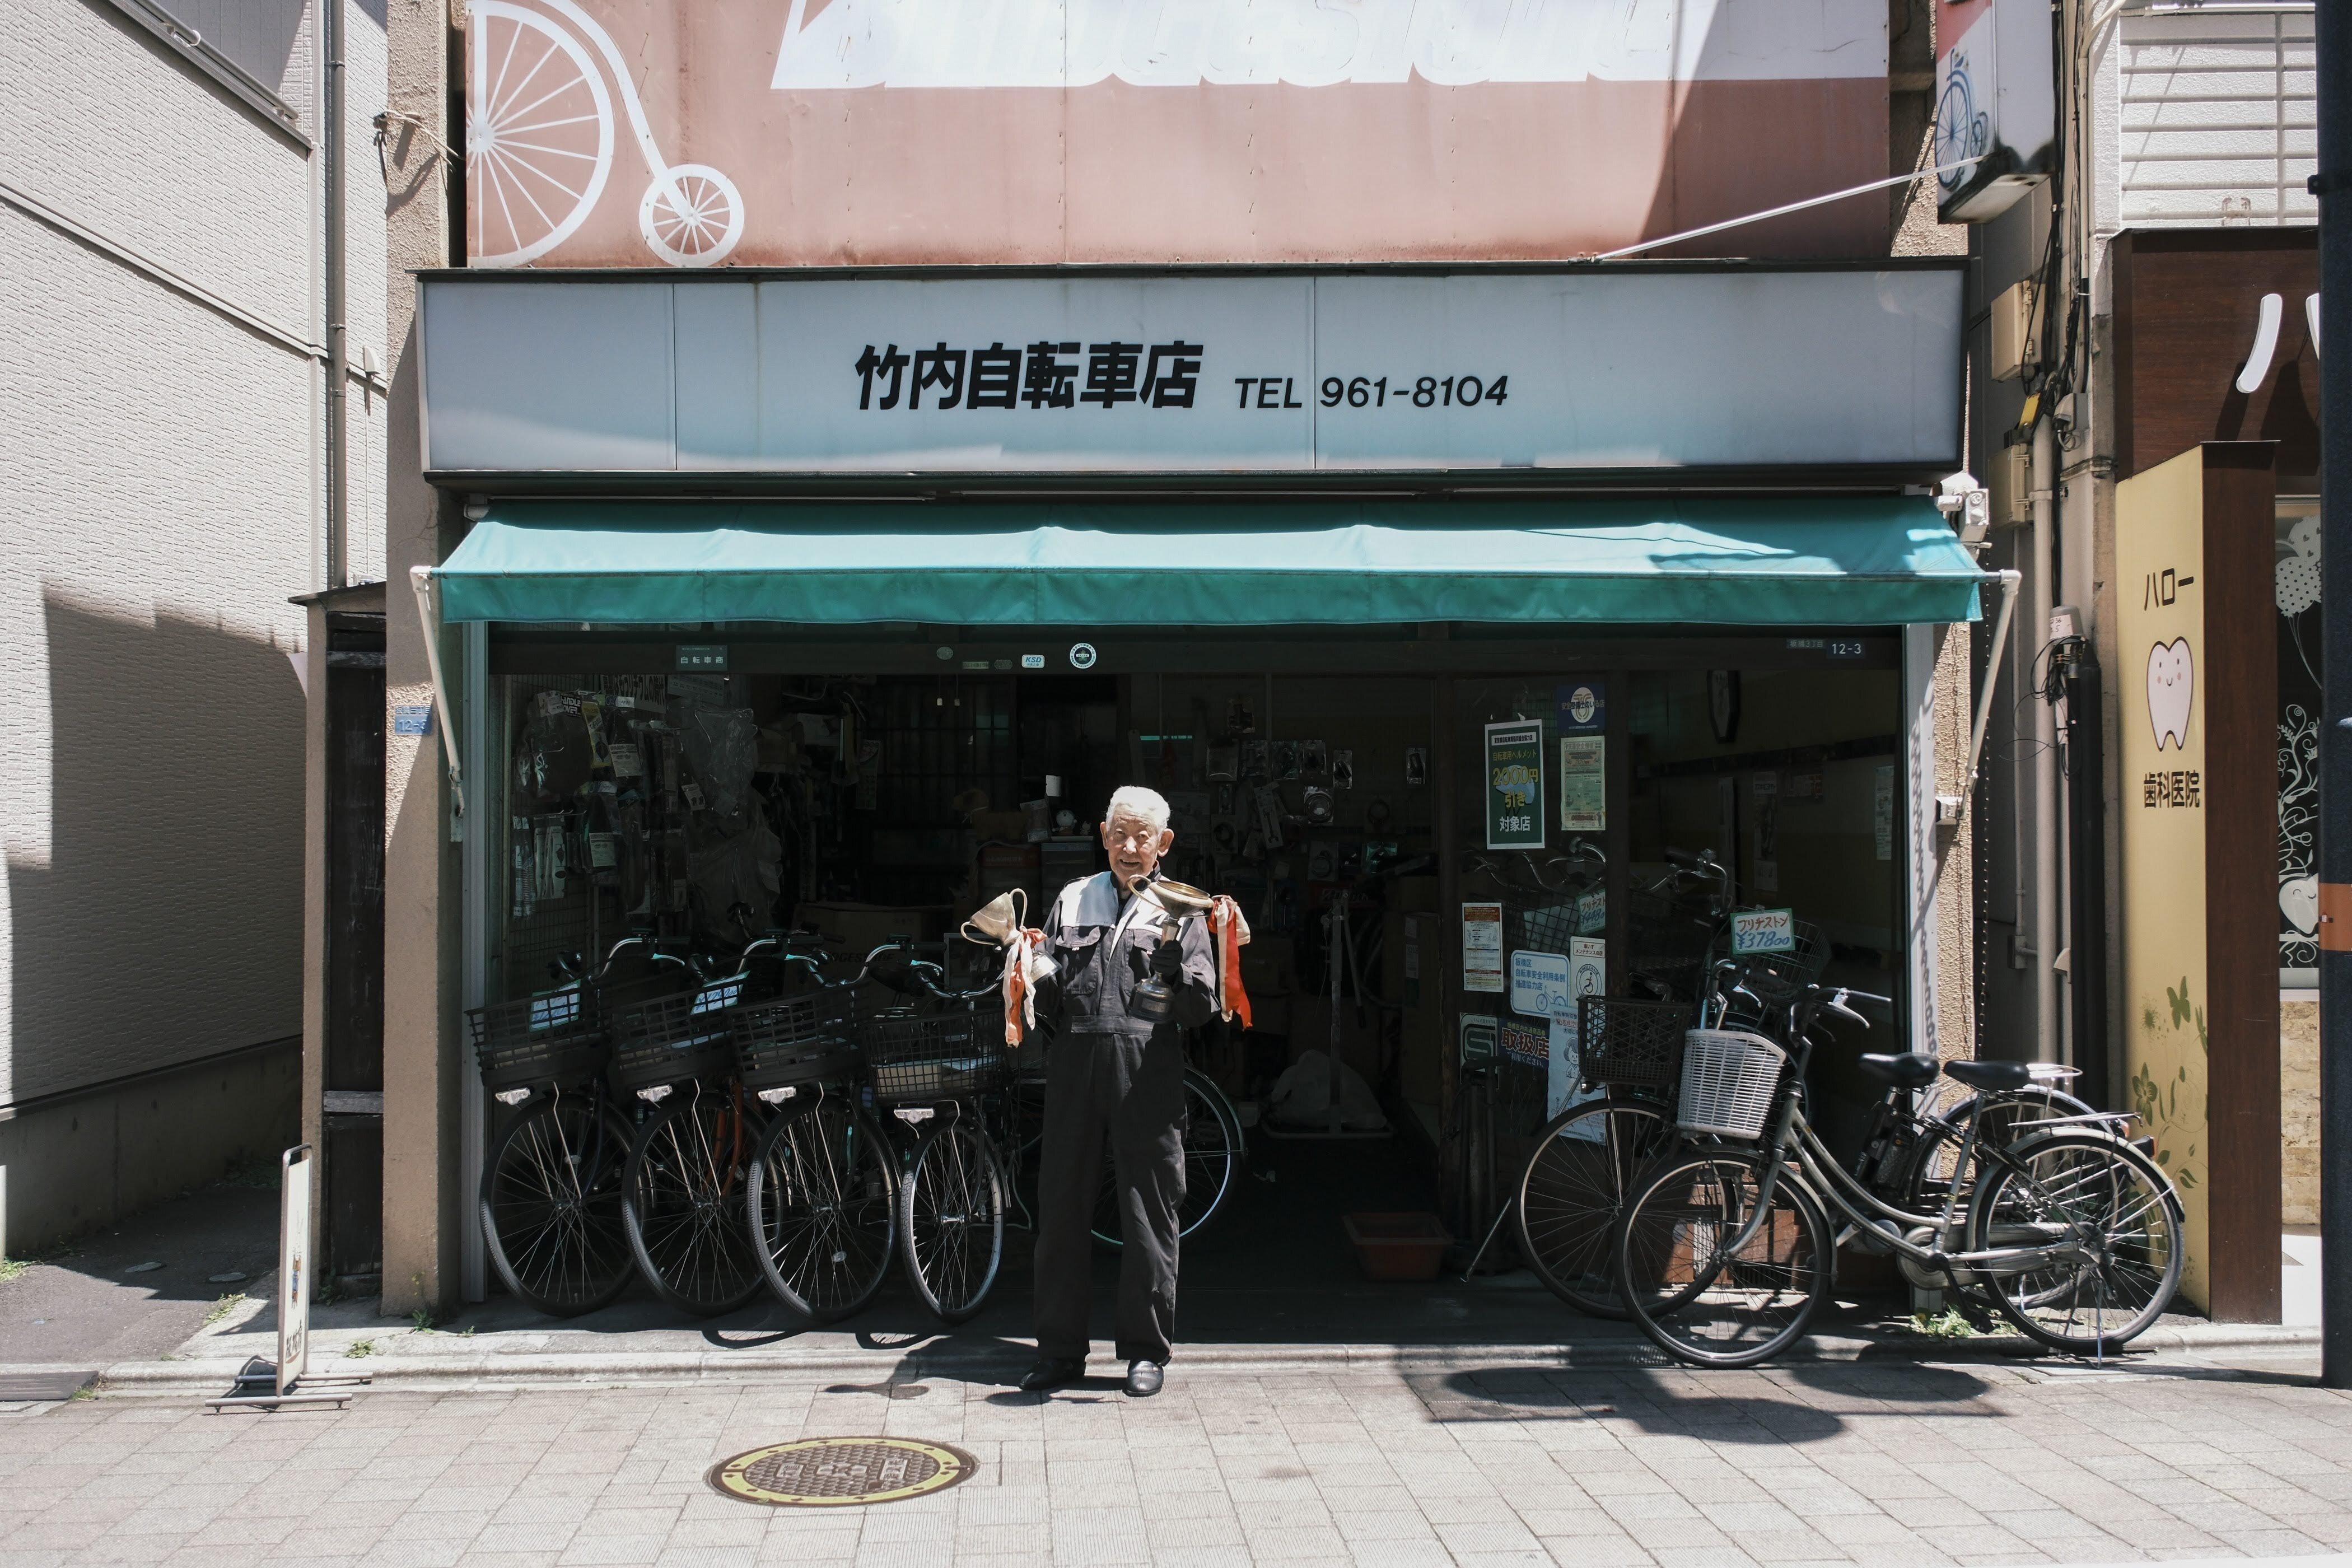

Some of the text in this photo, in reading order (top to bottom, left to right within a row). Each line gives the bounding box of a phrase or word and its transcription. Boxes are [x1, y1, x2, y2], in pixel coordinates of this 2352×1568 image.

[855, 340, 1509, 410] 竹内自転車店 TEL 961-8104
[2144, 568, 2194, 611] ハロー
[1832, 643, 1861, 655] 12-3
[396, 706, 430, 715] 板橋三丁目
[563, 705, 577, 715] OVER
[399, 720, 427, 732] 12-3
[1493, 750, 1537, 762] 自転車用ヘルメット
[1492, 766, 1539, 787] 2000円
[2143, 770, 2200, 808] 歯科医院
[1505, 790, 1526, 808] 引き
[1499, 815, 1531, 833] 対象店
[1737, 931, 1790, 950] ¥37800
[1515, 958, 1532, 968] 板橋区
[1515, 969, 1565, 983] 自転車安全利用条例
[1515, 980, 1543, 991] 推進協力店
[1507, 1021, 1546, 1037] 板橋区内共通商品券
[1501, 1028, 1550, 1059] 取扱店
